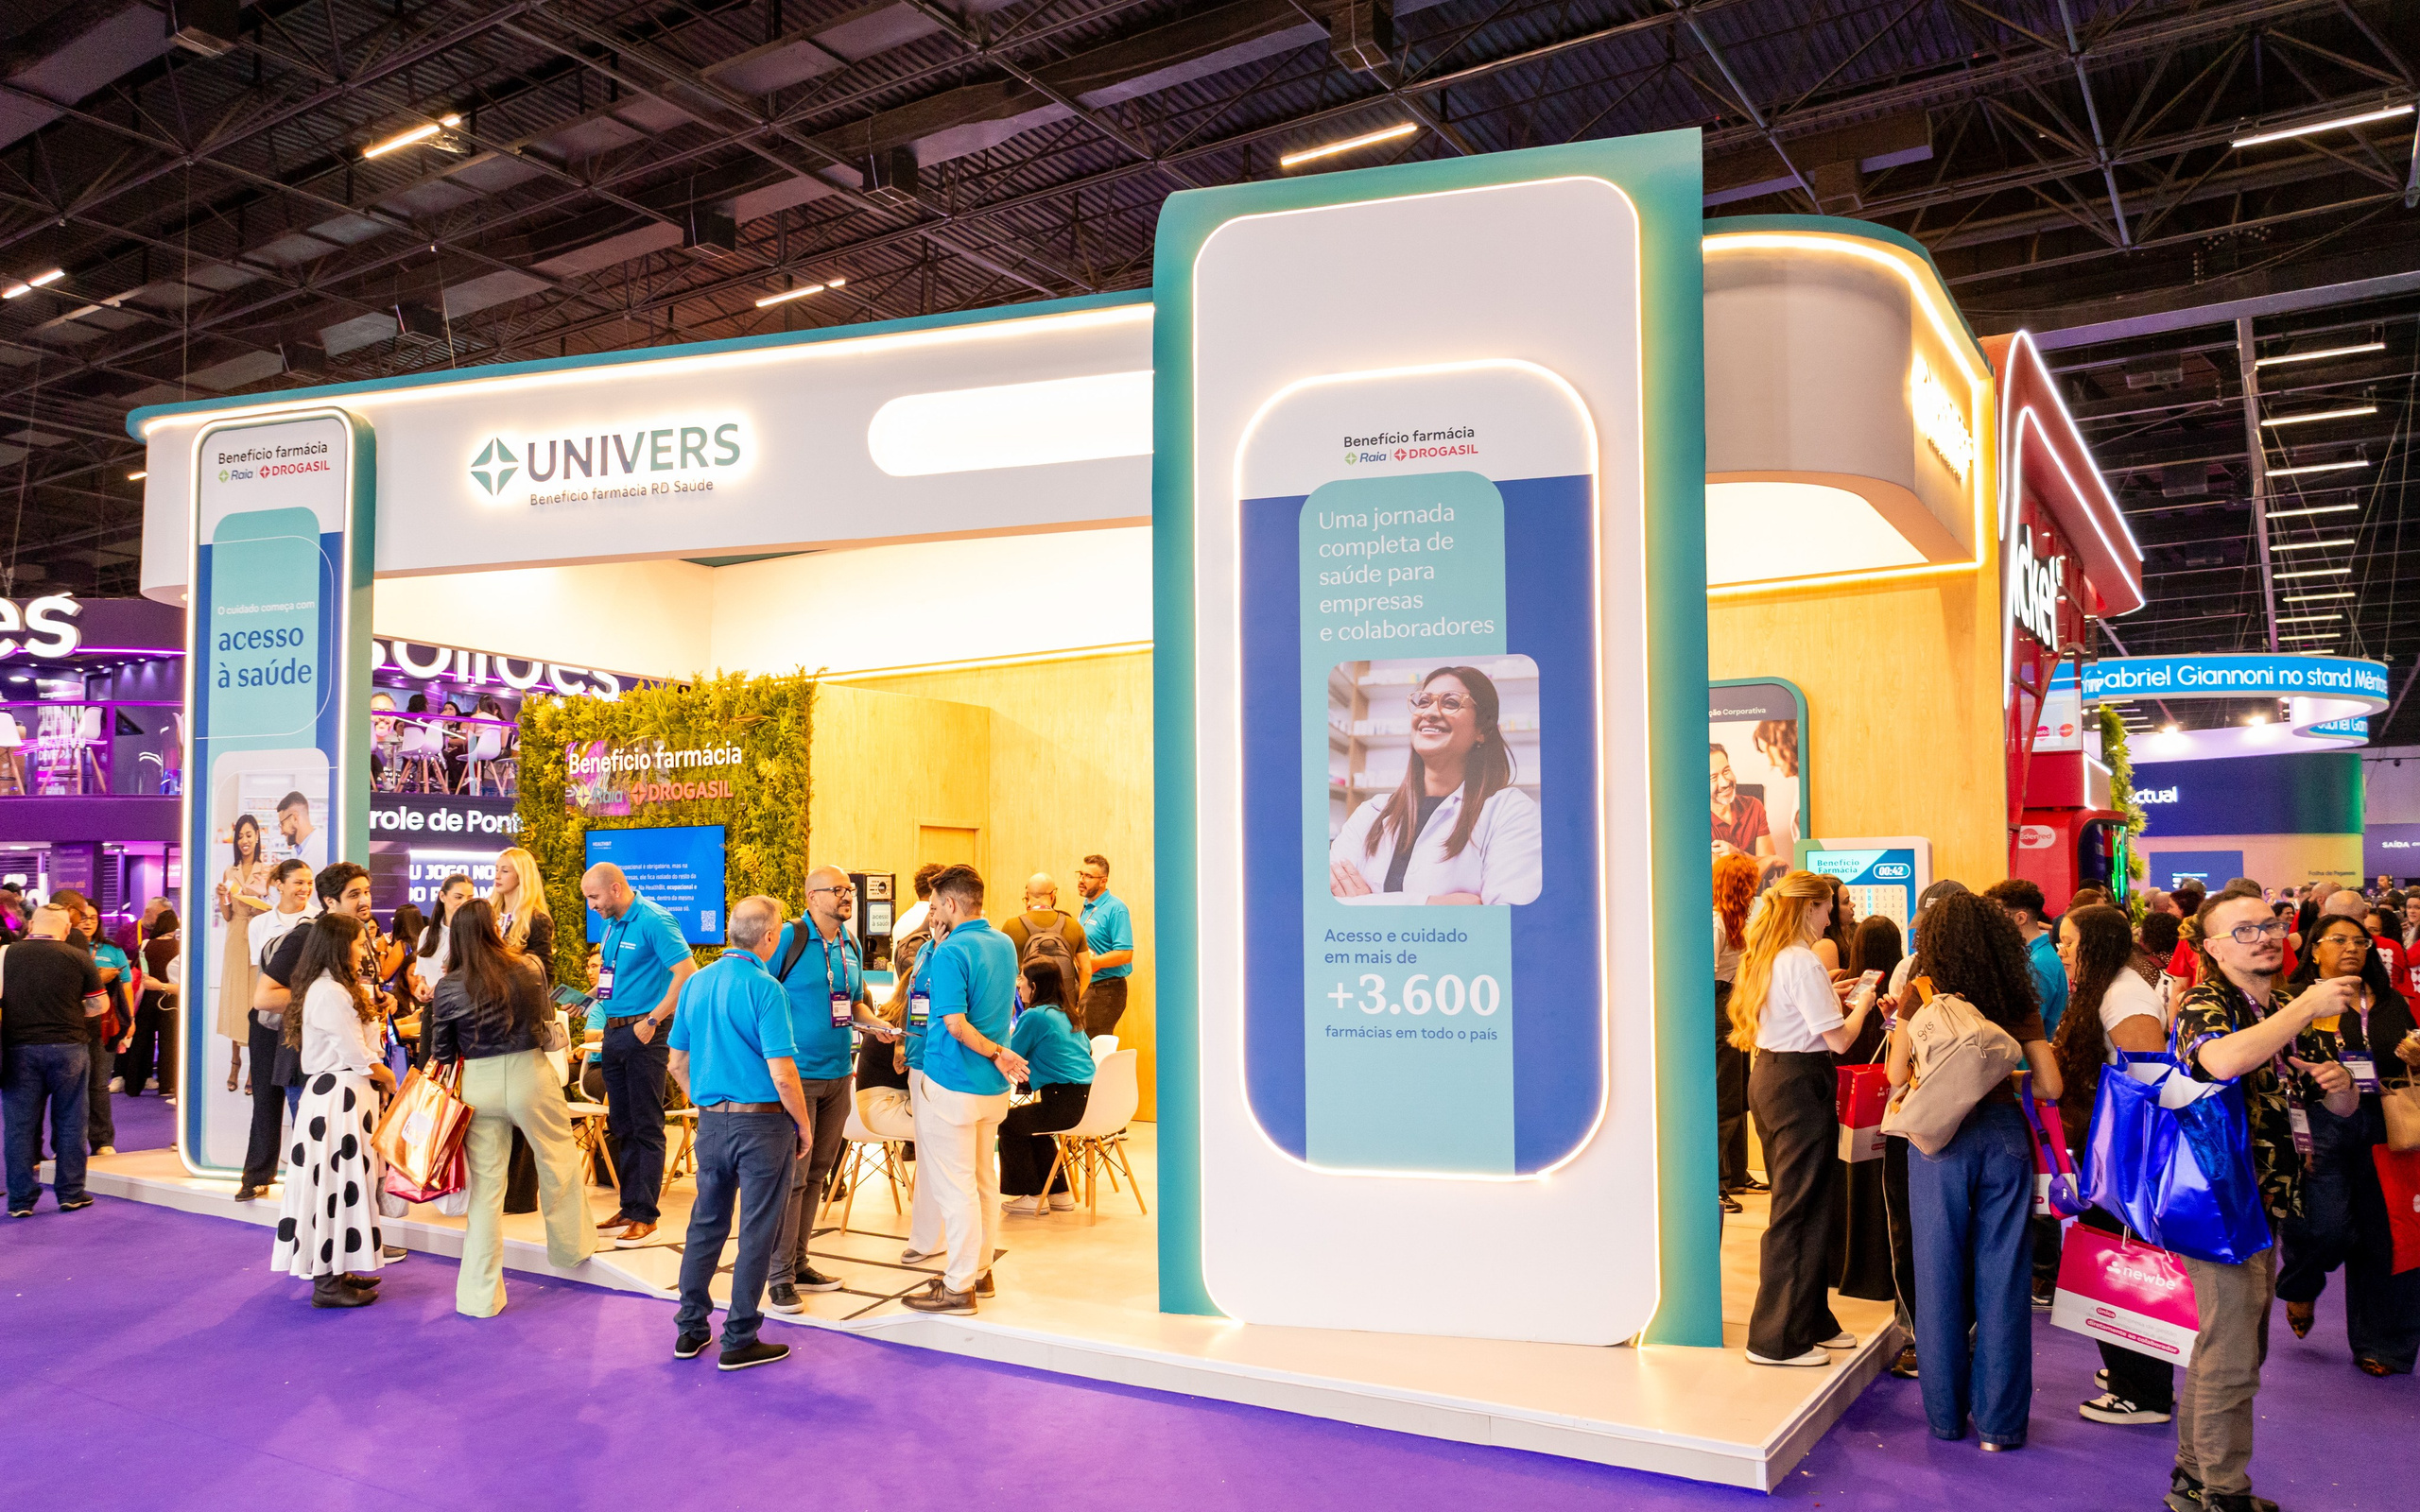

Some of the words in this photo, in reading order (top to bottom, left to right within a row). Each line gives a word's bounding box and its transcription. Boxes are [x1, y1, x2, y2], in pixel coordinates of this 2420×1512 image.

[1343, 431, 1409, 448] Benefício
[1412, 426, 1475, 442] farmácia
[218, 447, 272, 464] Benefício
[275, 441, 328, 459] farmácia
[527, 423, 740, 482] UNIVERS
[1359, 452, 1387, 463] Raia
[1409, 444, 1478, 459] DROGASIL
[231, 470, 253, 481] Raia
[272, 460, 330, 476] DROGASIL
[592, 485, 647, 501] farmácia
[651, 482, 669, 495] RD
[674, 478, 714, 493] Saúde
[1319, 511, 1368, 529] Uma
[1372, 503, 1455, 532] jornada
[1319, 535, 1420, 559] completa
[1426, 531, 1454, 551] de
[1319, 564, 1382, 586] saúde
[1388, 565, 1435, 587] para
[217, 607, 225, 615] O
[226, 604, 259, 615] cuidado
[261, 603, 294, 614] começa
[296, 600, 315, 610] com
[1320, 594, 1424, 616] empresas
[218, 627, 304, 651] acesso
[1320, 627, 1333, 642] e
[1338, 616, 1495, 641] colaboradores
[217, 662, 230, 688] à
[237, 658, 312, 687] saúde
[2177, 665, 2273, 686] Giannoni
[2279, 669, 2304, 685] no
[2308, 667, 2351, 688] stand
[1722, 707, 1766, 716] Corporativa
[568, 746, 651, 775] Benefício
[655, 740, 742, 769] farmácia
[593, 786, 623, 803] Raia
[648, 780, 734, 802] DROGASIL
[428, 808, 463, 832] de
[2382, 840, 2410, 849] SAÍDA
[1878, 867, 1904, 876] 00:42
[1324, 928, 1382, 942] Acesso
[1387, 932, 1396, 942] e
[1401, 928, 1468, 942] cuidado
[1324, 953, 1350, 964] em
[1355, 950, 1392, 964] mais
[1396, 950, 1417, 964] de
[1327, 973, 1500, 1016] +3.600
[1325, 1024, 1392, 1038] farmácias
[1395, 1028, 1417, 1039] em
[1421, 1027, 1453, 1040] todo
[1458, 1030, 1466, 1040] o
[1470, 1027, 1497, 1042] país
[2123, 1266, 2175, 1290] newbe
[2098, 1308, 2115, 1317] única
[2087, 1319, 2127, 1336] diretamente
[2137, 1335, 2178, 1353] colaborador
